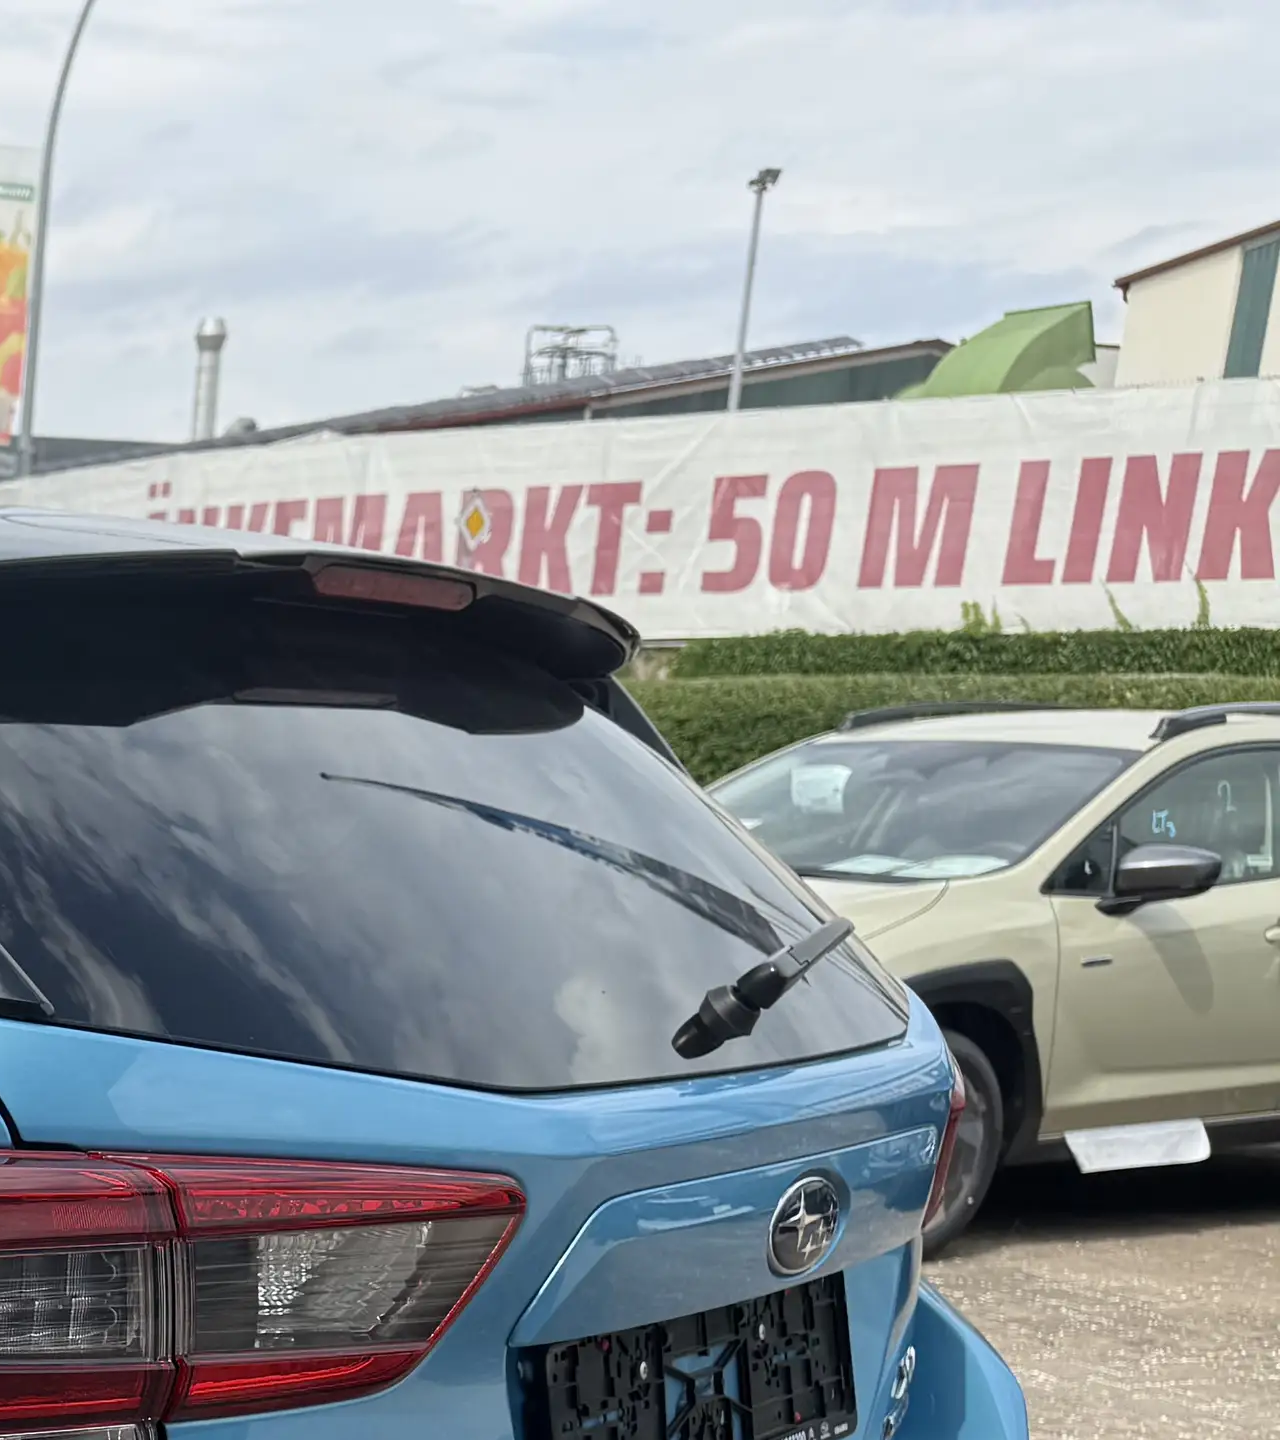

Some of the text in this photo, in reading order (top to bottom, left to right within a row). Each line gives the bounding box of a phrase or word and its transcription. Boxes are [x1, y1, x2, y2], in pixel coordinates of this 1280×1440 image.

[700, 469, 838, 594] 50
[857, 463, 981, 589] M
[1000, 447, 1280, 587] LINK
